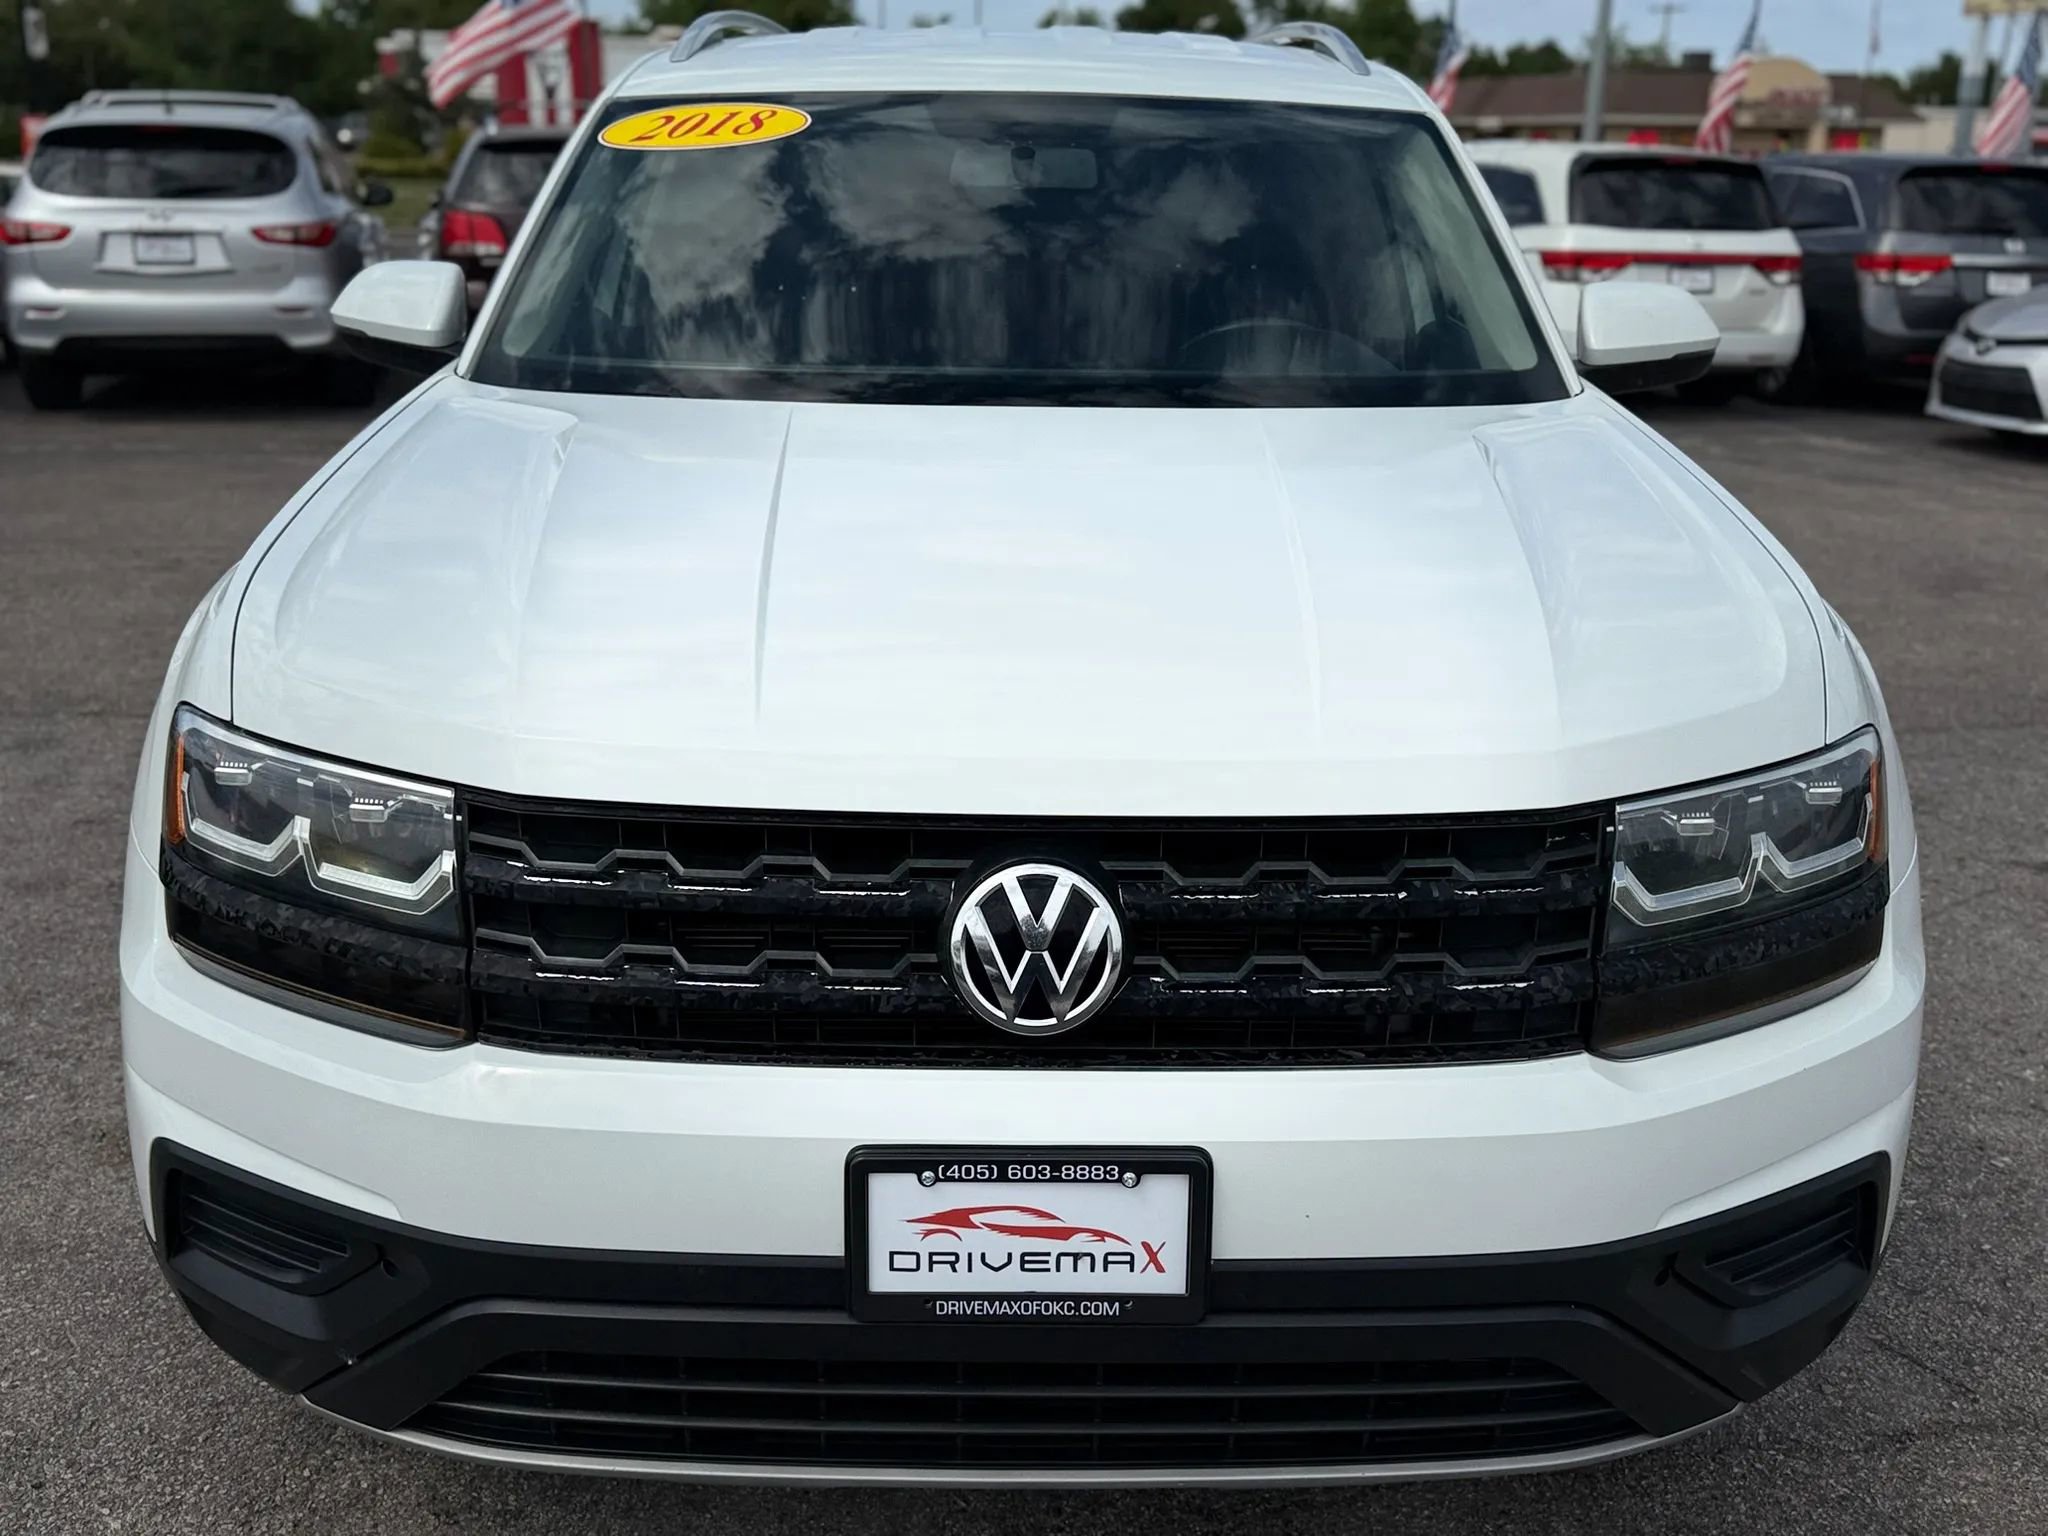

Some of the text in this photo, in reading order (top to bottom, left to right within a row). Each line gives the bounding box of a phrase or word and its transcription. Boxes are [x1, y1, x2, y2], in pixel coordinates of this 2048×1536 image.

[627, 109, 778, 143] 2018
[938, 1164, 1119, 1181] (405) 603-8883
[888, 1240, 1167, 1274] DRIVEMAX
[935, 1300, 1120, 1316] DRIVEMAXOFOKC.COM
